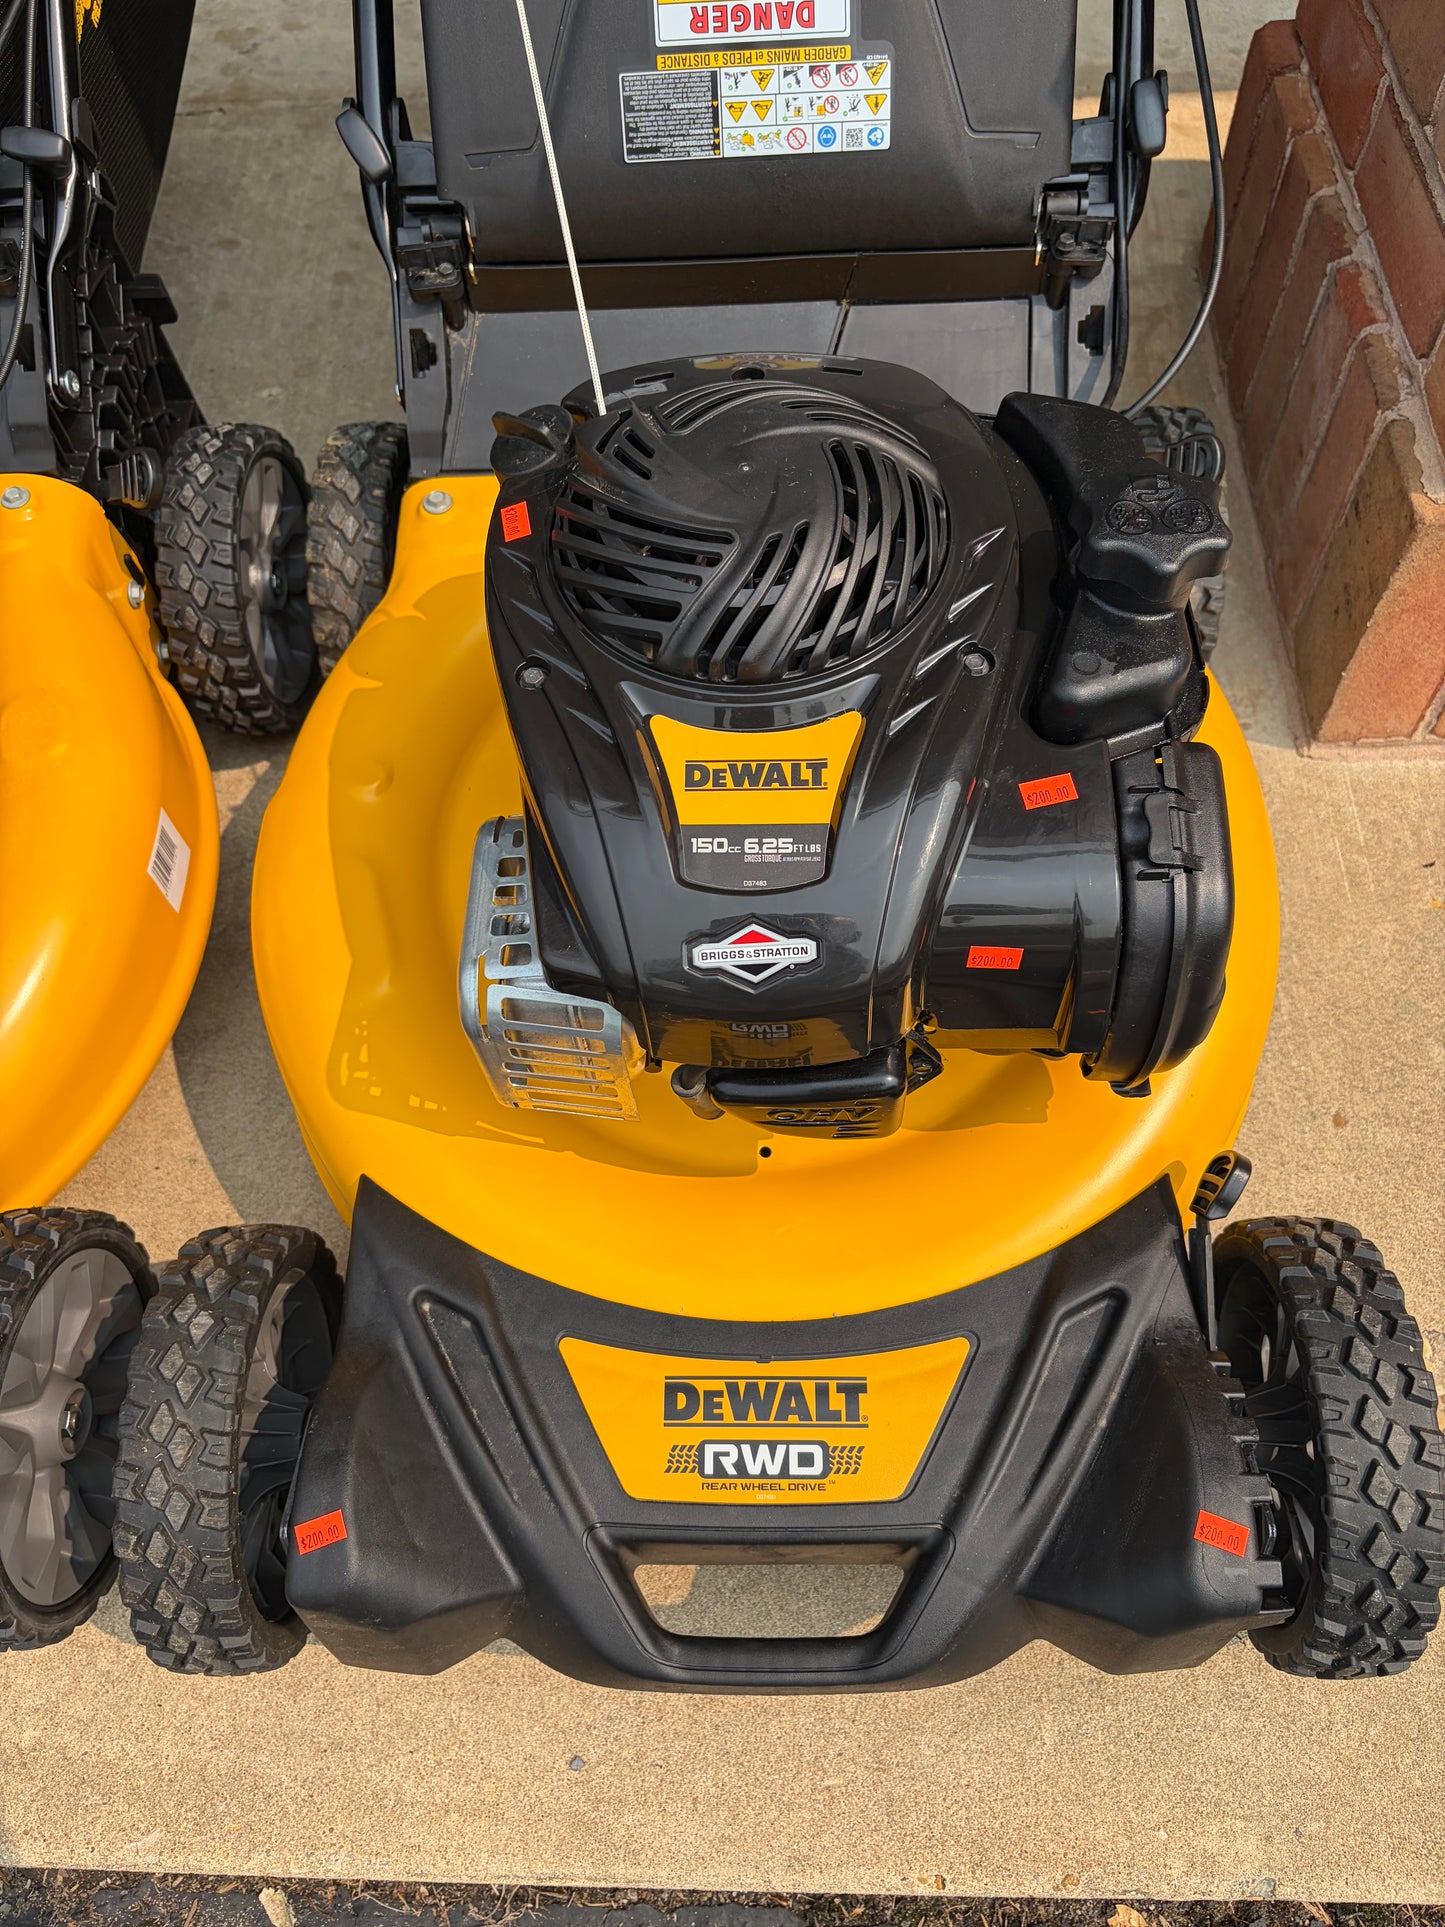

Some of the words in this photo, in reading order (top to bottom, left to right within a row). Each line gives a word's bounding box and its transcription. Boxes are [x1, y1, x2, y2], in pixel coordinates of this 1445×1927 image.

[690, 1, 815, 34] DANGER
[722, 52, 752, 65] PIEDS
[755, 51, 764, 61] et
[767, 49, 800, 62] MAINS
[804, 47, 847, 60] GARDER
[660, 54, 710, 69] DISTANCE
[1026, 785, 1070, 807] $200.00
[805, 843, 822, 853] LBS
[744, 854, 762, 863] GROSS
[762, 854, 782, 863] TORQUE
[970, 955, 1013, 968] $200.00
[704, 1443, 823, 1476] RWD
[701, 1482, 738, 1491] REAR
[740, 1482, 786, 1491] WHEEL
[787, 1482, 827, 1491] DRIVE
[301, 1524, 340, 1551] $200.00
[1198, 1523, 1240, 1551] $200.00
